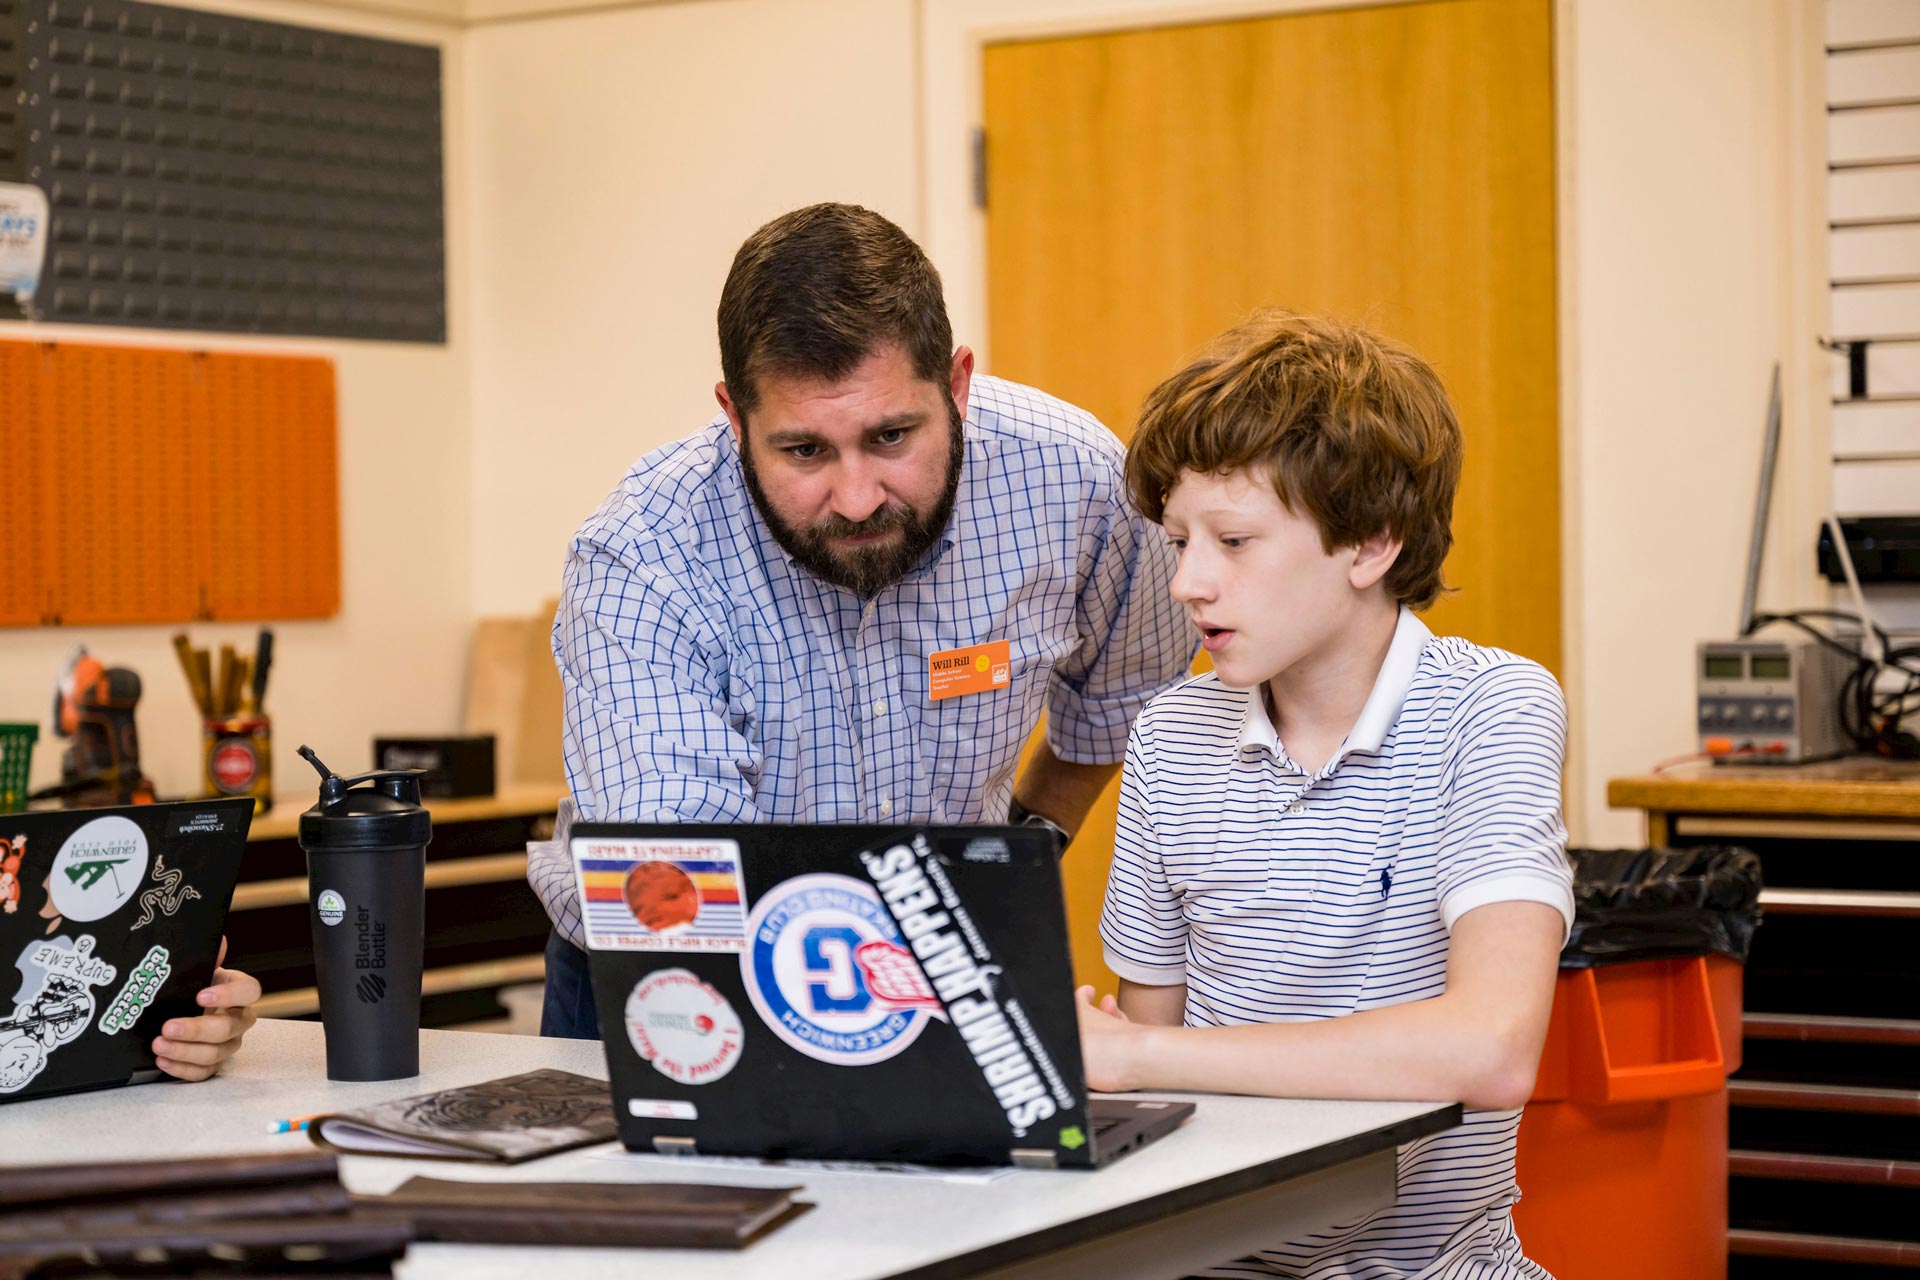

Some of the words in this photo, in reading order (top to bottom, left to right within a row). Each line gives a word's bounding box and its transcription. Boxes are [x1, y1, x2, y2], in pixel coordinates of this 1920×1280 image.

[932, 659, 952, 670] Will
[954, 656, 970, 667] Rill
[932, 677, 954, 685] Computer
[70, 845, 137, 858] GREENWICH
[108, 839, 137, 847] POLO
[354, 905, 370, 969] Blender
[370, 922, 386, 969] Bottle
[34, 948, 113, 982] SUPREME
[144, 951, 165, 972] be
[139, 965, 168, 1003] yeet
[105, 972, 147, 1028] yeeted
[124, 1004, 140, 1025] or
[780, 1010, 907, 1053] GREENWICH
